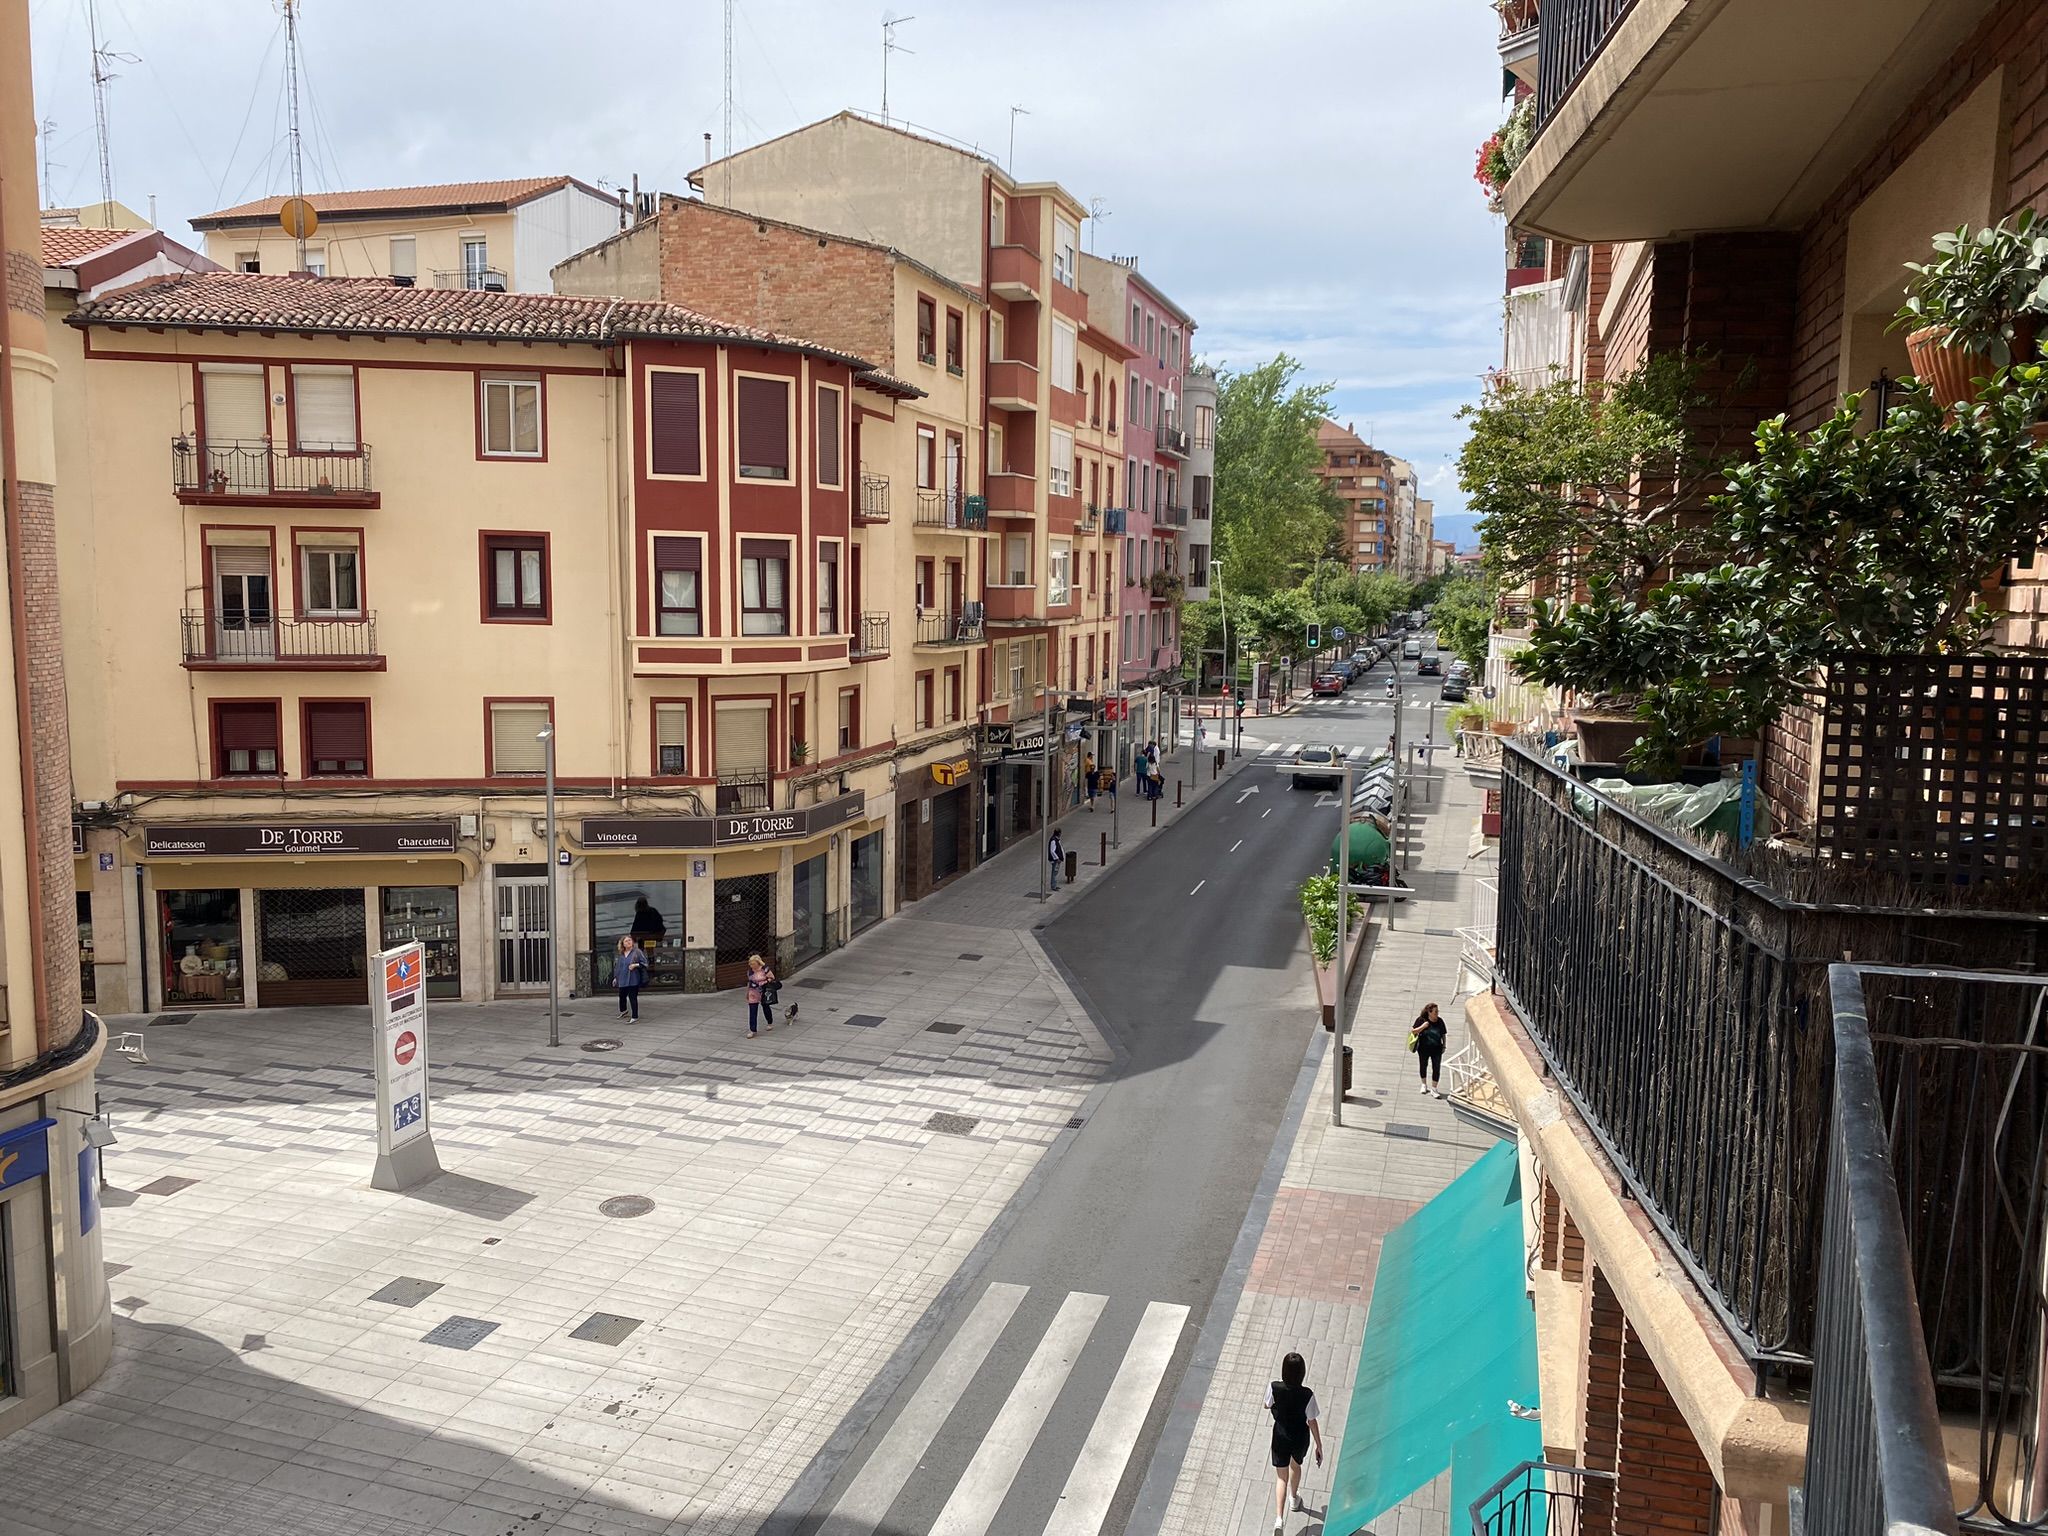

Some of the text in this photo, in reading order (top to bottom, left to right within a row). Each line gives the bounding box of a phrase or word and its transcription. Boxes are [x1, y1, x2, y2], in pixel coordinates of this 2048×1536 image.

[729, 817, 795, 836] DE TORRE
[260, 828, 344, 845] DE TORRE
[596, 833, 638, 842] Vinoteca
[748, 832, 777, 842] Gourmet
[149, 840, 206, 850] Delicatessen
[284, 844, 321, 853] Gourmet
